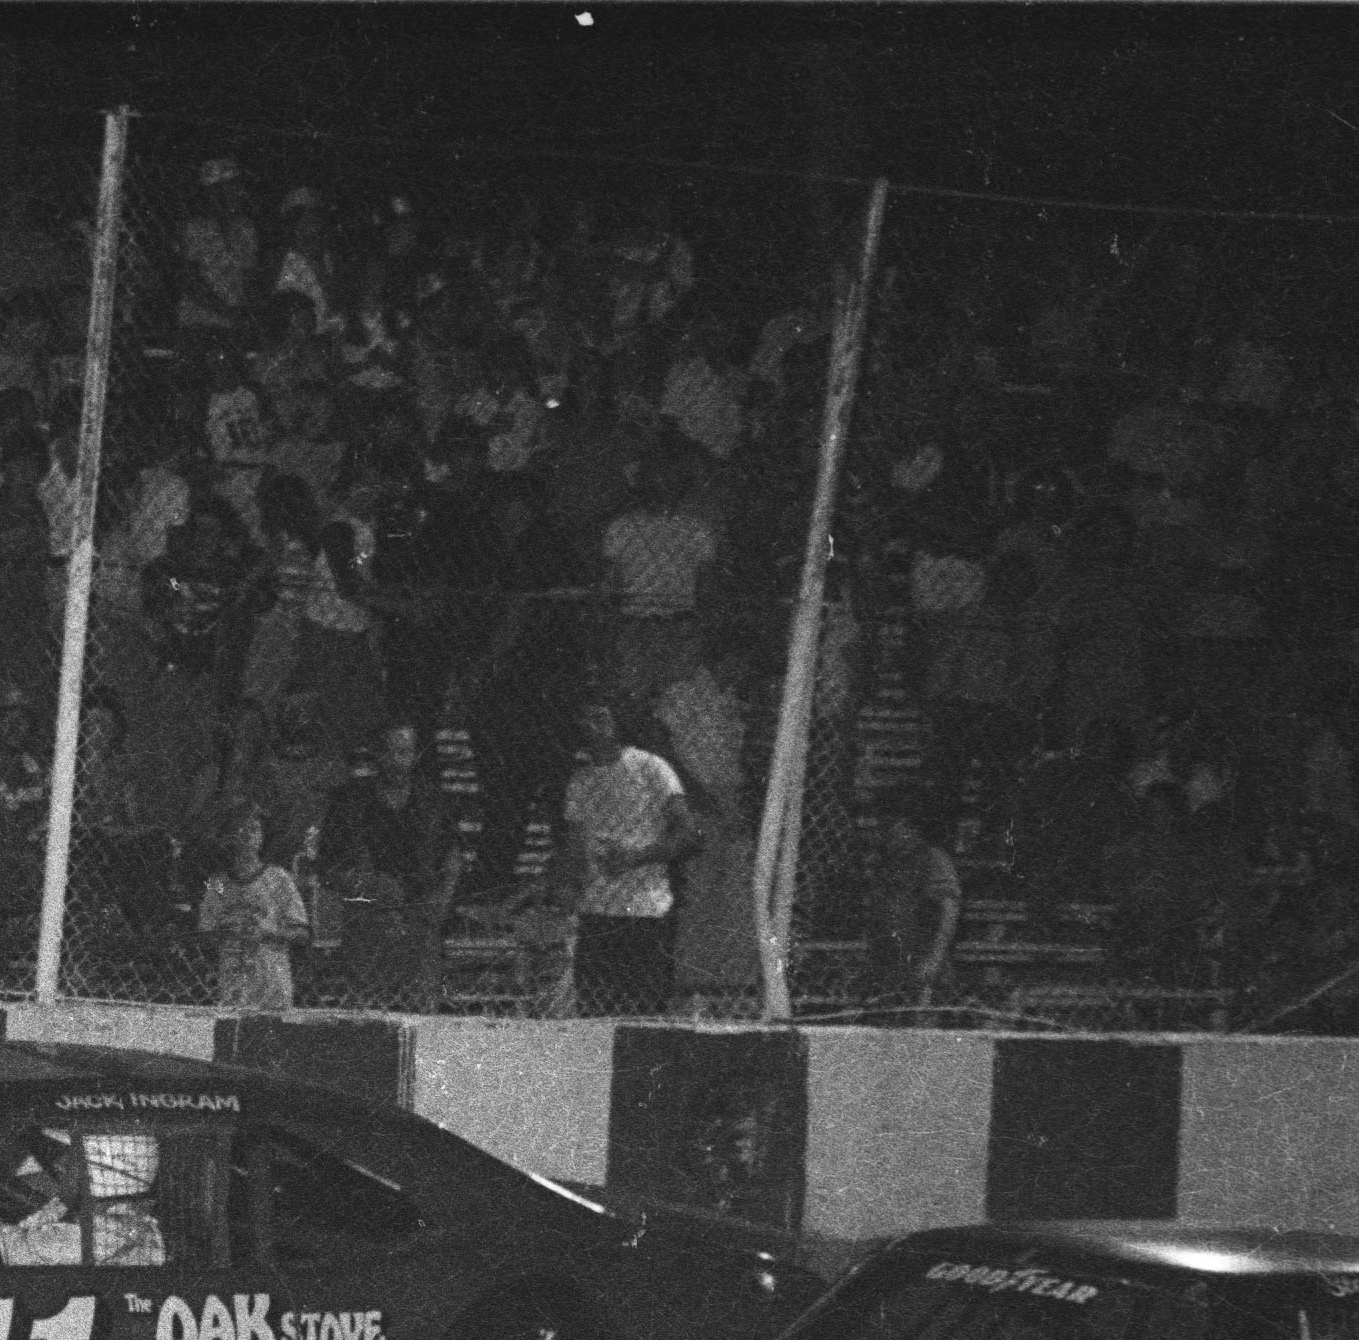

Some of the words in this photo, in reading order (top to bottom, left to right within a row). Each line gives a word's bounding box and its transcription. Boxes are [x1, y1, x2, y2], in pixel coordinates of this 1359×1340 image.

[55, 1093, 125, 1111] JACK
[129, 1092, 241, 1112] INGRAM
[924, 1261, 1099, 1304] GOODYEAR
[123, 1292, 153, 1314] The
